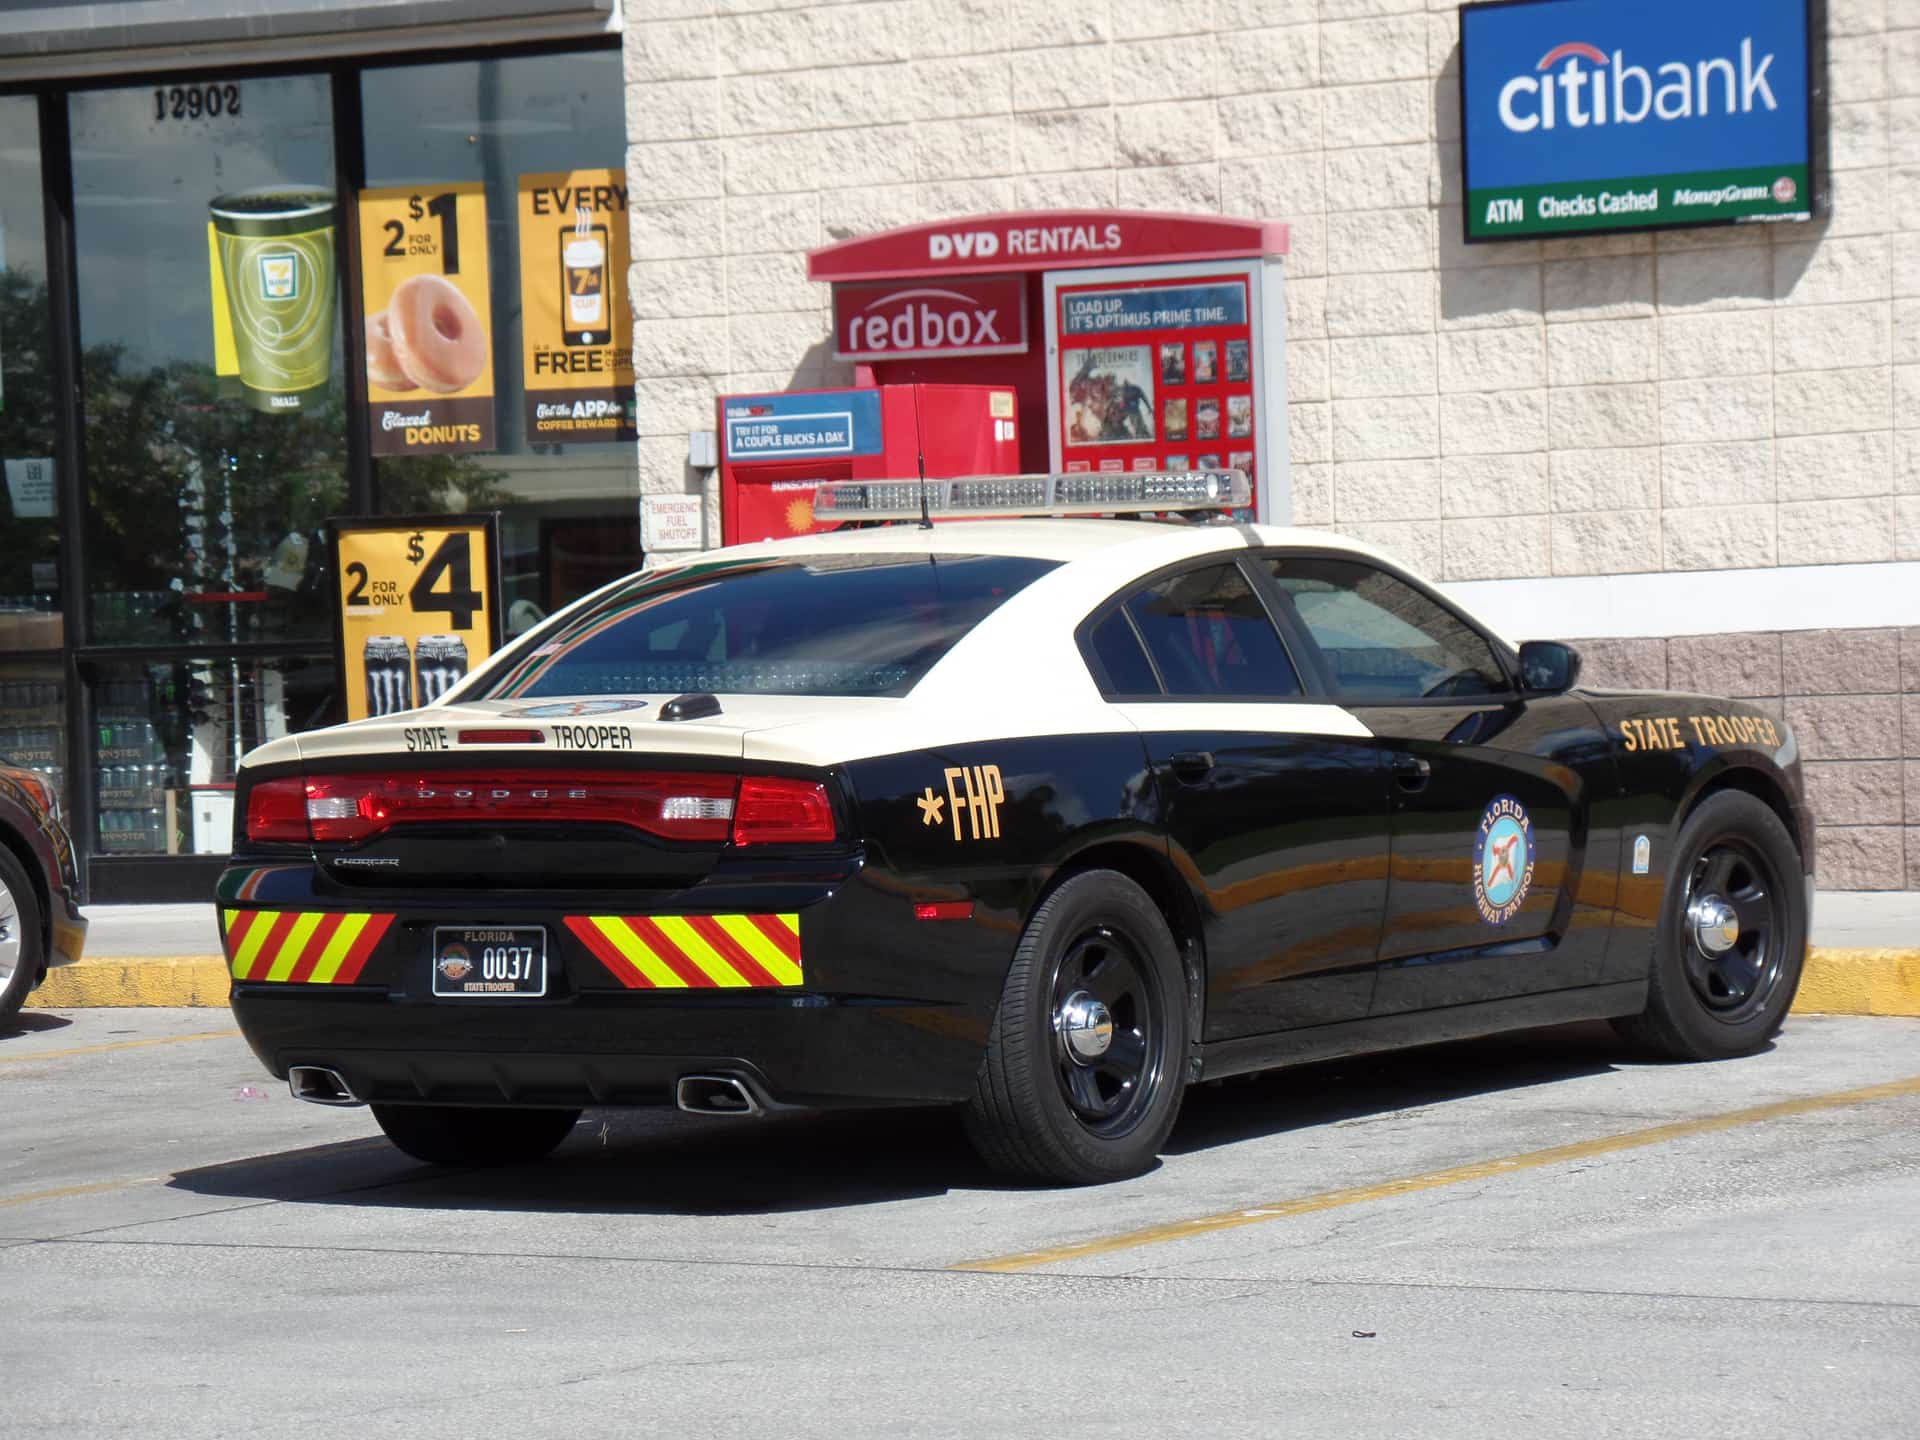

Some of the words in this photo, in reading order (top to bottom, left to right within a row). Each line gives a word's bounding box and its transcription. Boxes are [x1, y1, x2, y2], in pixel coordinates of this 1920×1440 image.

[1498, 37, 1778, 133] citibank
[155, 85, 240, 121] 12902
[532, 184, 629, 215] EVERY
[1538, 193, 1597, 219] Checks
[1598, 188, 1659, 214] Cashed
[1673, 184, 1769, 206] MoneyGram
[1486, 198, 1524, 224] ATM
[383, 219, 406, 257] 2
[408, 233, 432, 244] FOR
[929, 231, 999, 260] DVD
[1007, 223, 1122, 255] RENTALS
[409, 245, 438, 256] ONLY
[1070, 301, 1102, 315] LOAD
[1104, 299, 1124, 313] UP.
[1070, 315, 1094, 330] IT'S
[1095, 312, 1151, 329] OPTIMUS
[1153, 308, 1192, 324] PRIME
[1196, 306, 1228, 321] TIME.
[849, 303, 1001, 351] redbox
[534, 350, 603, 375] FREE
[572, 400, 608, 419] APP
[405, 424, 481, 445] DONUTS
[537, 420, 574, 431] COFFEE
[736, 426, 751, 436] TRY
[752, 425, 760, 435] IT
[761, 424, 779, 434] FOR
[735, 438, 744, 448] A
[744, 435, 782, 447] COUPLE
[783, 433, 815, 446] BUCKS
[816, 432, 825, 444] A
[666, 515, 688, 527] FUEL
[345, 561, 370, 606] 2
[372, 582, 397, 593] FOR
[372, 595, 405, 606] ONLY
[404, 726, 449, 752] STATE
[551, 724, 633, 750] TROOPER
[1620, 716, 1686, 752] STATE
[1688, 714, 1782, 748] TROOPER
[417, 788, 588, 799] DODGE
[1481, 799, 1530, 835] FLORIDA
[334, 857, 401, 867] CHARGER
[1473, 863, 1502, 924] HIGHWAY
[1503, 861, 1535, 921] PATROL
[464, 931, 515, 942] FLORIDA
[483, 946, 533, 980] 0037
[463, 982, 483, 992] STATE
[484, 982, 515, 992] TROOPER
